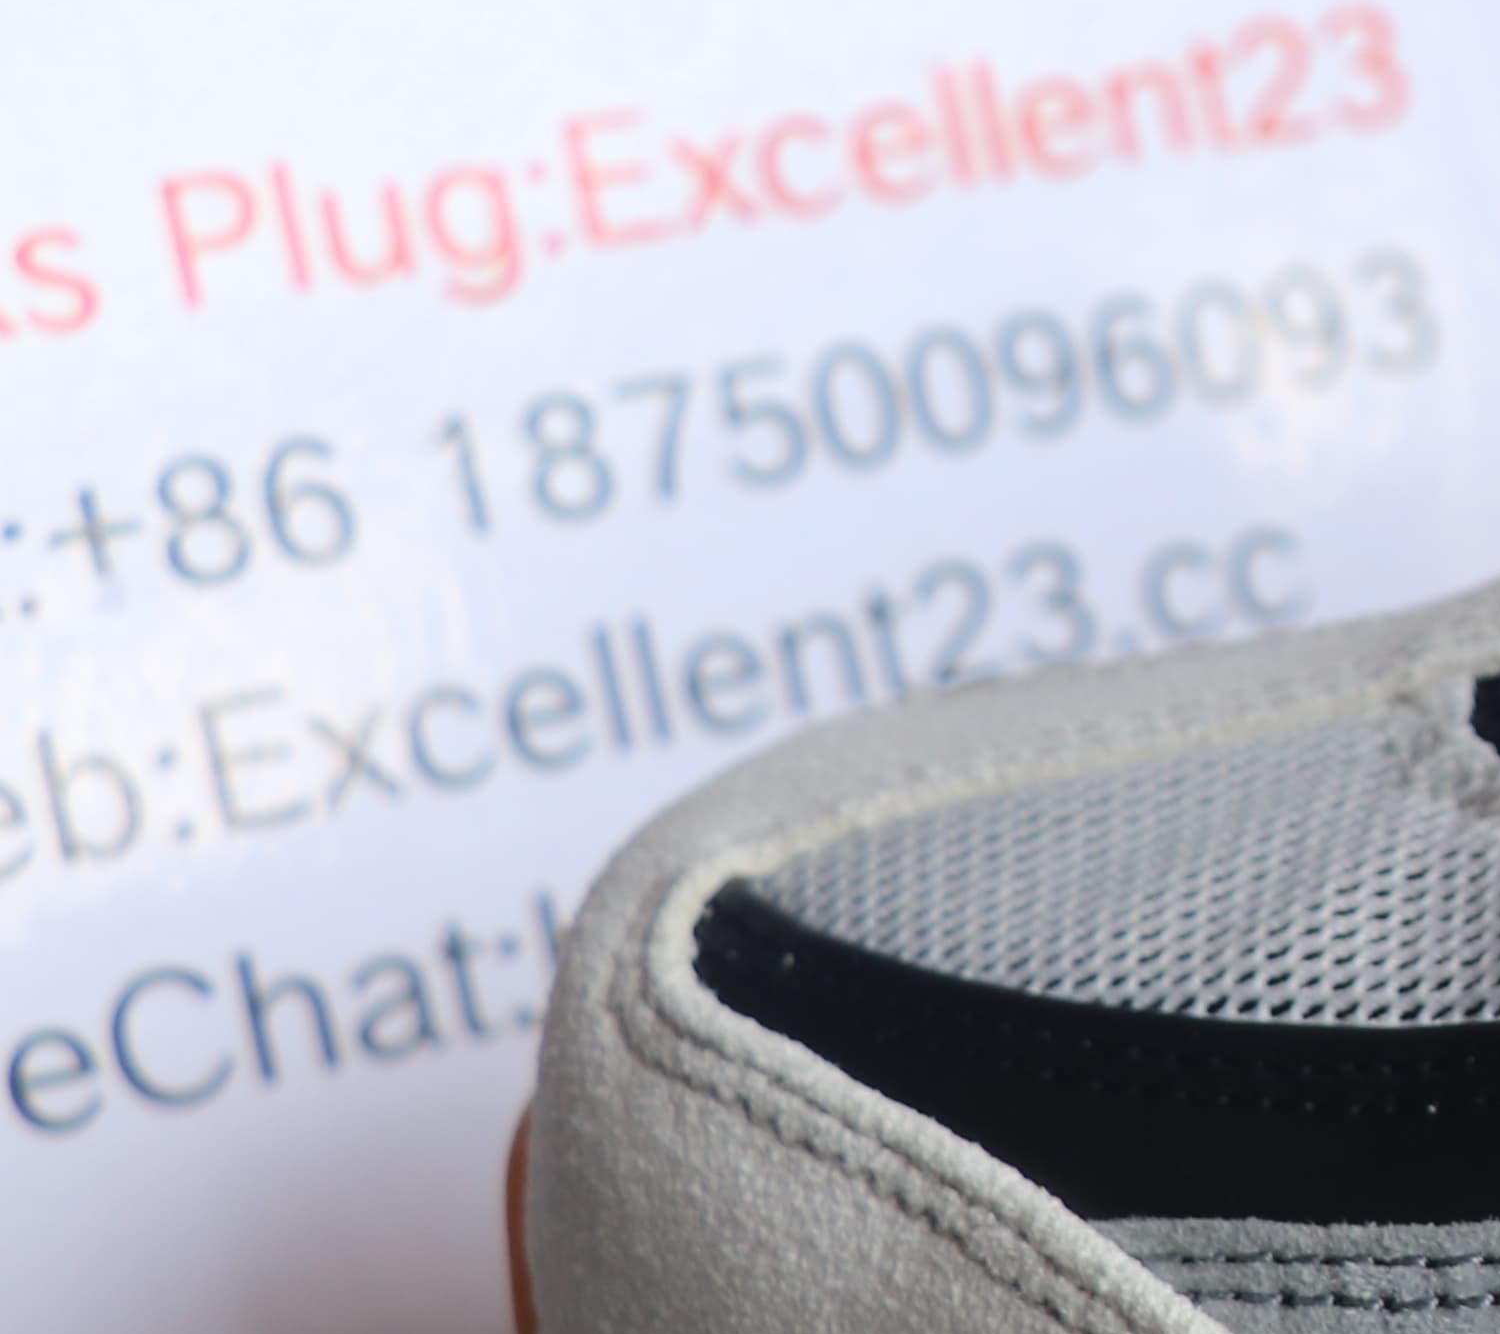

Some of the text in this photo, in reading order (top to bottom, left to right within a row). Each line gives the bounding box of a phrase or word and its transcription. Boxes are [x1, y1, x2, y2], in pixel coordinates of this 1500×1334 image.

[0, 2, 1412, 339] s Plug:Excellent23
[436, 247, 1441, 537] 18750096093
